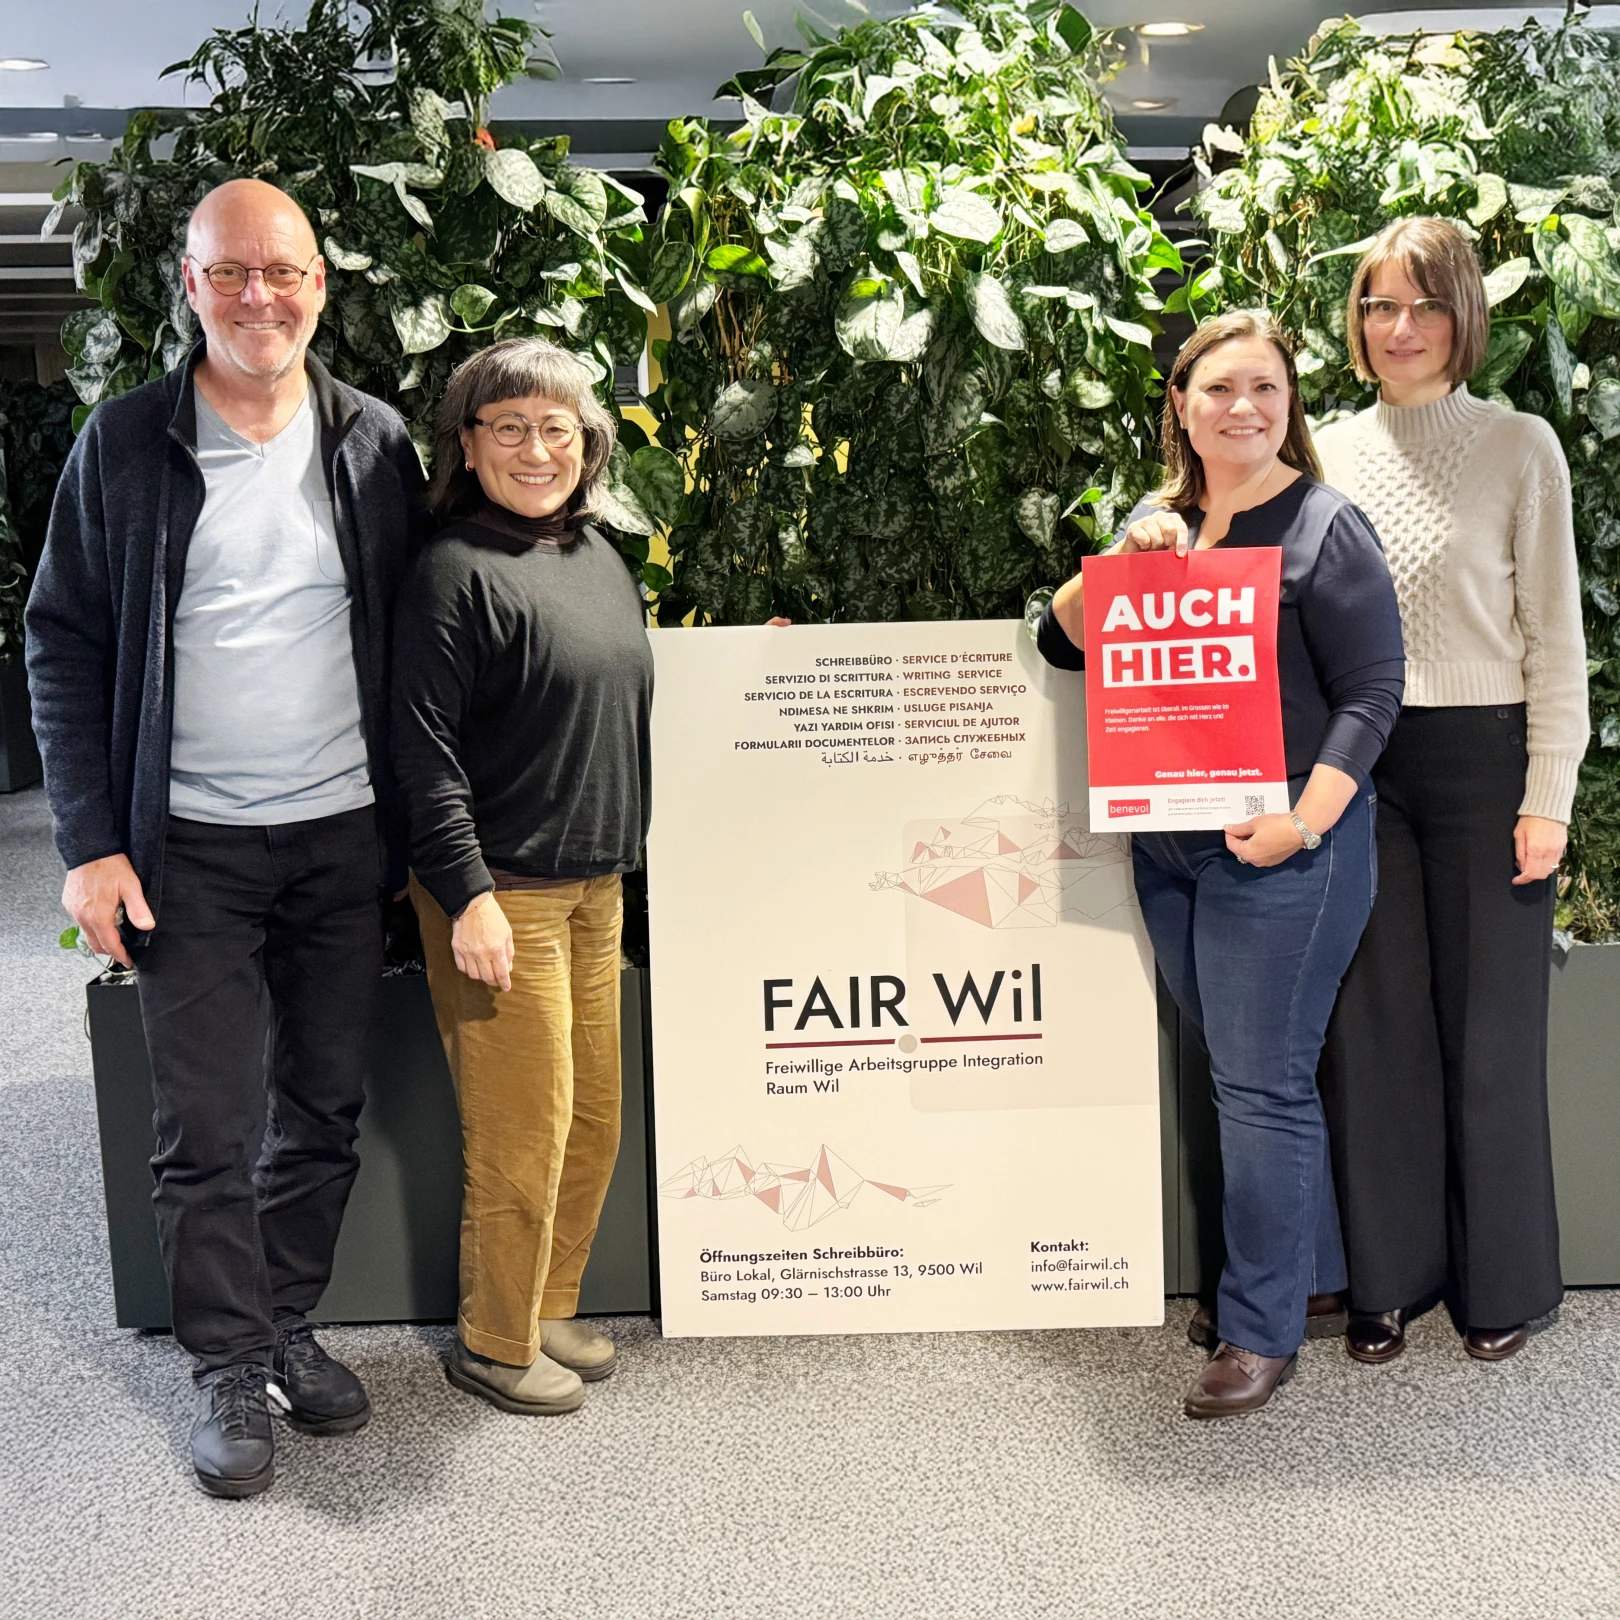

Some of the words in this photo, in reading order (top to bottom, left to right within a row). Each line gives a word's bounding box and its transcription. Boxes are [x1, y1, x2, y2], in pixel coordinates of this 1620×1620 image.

[1101, 587, 1255, 632] AUCH
[815, 654, 893, 667] SCHREIBBÜRO
[902, 654, 947, 665] SERVICE
[1110, 644, 1250, 683] HIER.
[765, 675, 816, 684] SERVIZIO
[819, 674, 831, 683] DI
[834, 673, 893, 683] SCRITTURA
[903, 671, 951, 680] WRITING
[957, 670, 1002, 679] SERVICE
[744, 691, 796, 701] SERVICIO
[799, 691, 813, 700] DE
[817, 690, 831, 699] LA
[834, 689, 893, 699] ESCRITURA
[903, 686, 976, 697] ESCREVENDO
[980, 685, 1027, 697] SERVIÇO
[779, 707, 830, 717] NDIMESA
[833, 706, 848, 715] NE
[852, 705, 894, 714] SHKRIM
[904, 704, 946, 713] USLUGE
[949, 702, 994, 713] PISANJA
[1104, 707, 1151, 715] Freiwilligenarbeit
[794, 723, 818, 732] YAZI
[821, 722, 863, 731] YARDIM
[866, 721, 894, 730] OFISI
[904, 719, 959, 729] SERVICIUL
[963, 718, 977, 727] DE
[980, 718, 1020, 728] AJUTOR
[735, 740, 801, 750] FORMULARII
[805, 737, 895, 748] DOCUMENTELOR
[905, 735, 950, 745] ЗАПИСЬ
[953, 733, 1026, 743] СЛУЖЕБНЫХ
[821, 752, 859, 768] الكتابة
[863, 751, 894, 763] خدمة
[1155, 770, 1185, 778] Genau
[1186, 769, 1208, 778] hier,
[1209, 770, 1237, 778] genau
[1238, 768, 1263, 778] jetzt.
[1110, 804, 1149, 814] benevol
[763, 975, 910, 1032] FAIR
[932, 964, 1042, 1027] Wil
[765, 1060, 843, 1076] Freiwillige
[849, 1056, 958, 1073] Arbeitsgruppe
[963, 1053, 1044, 1070] Integration
[766, 1082, 808, 1095] Raum
[813, 1078, 840, 1093] Wil
[1030, 1239, 1089, 1253] Kontakt:
[699, 1249, 808, 1265] Öffnungszeiten
[812, 1246, 904, 1260] Schreibbüro:
[700, 1270, 732, 1283] Büro
[736, 1268, 776, 1283] Lokal,
[780, 1266, 889, 1281] Glärnischstrasse
[892, 1265, 913, 1279] 13,
[918, 1264, 955, 1277] 9500
[959, 1262, 983, 1275] Wil
[1031, 1257, 1129, 1273] info@fairwil.ch
[1031, 1277, 1129, 1292] www.fairwil.ch
[701, 1290, 757, 1303] Samstag
[761, 1288, 803, 1300] 09:30
[823, 1286, 863, 1299] 13:00
[867, 1285, 892, 1298] Uhr
